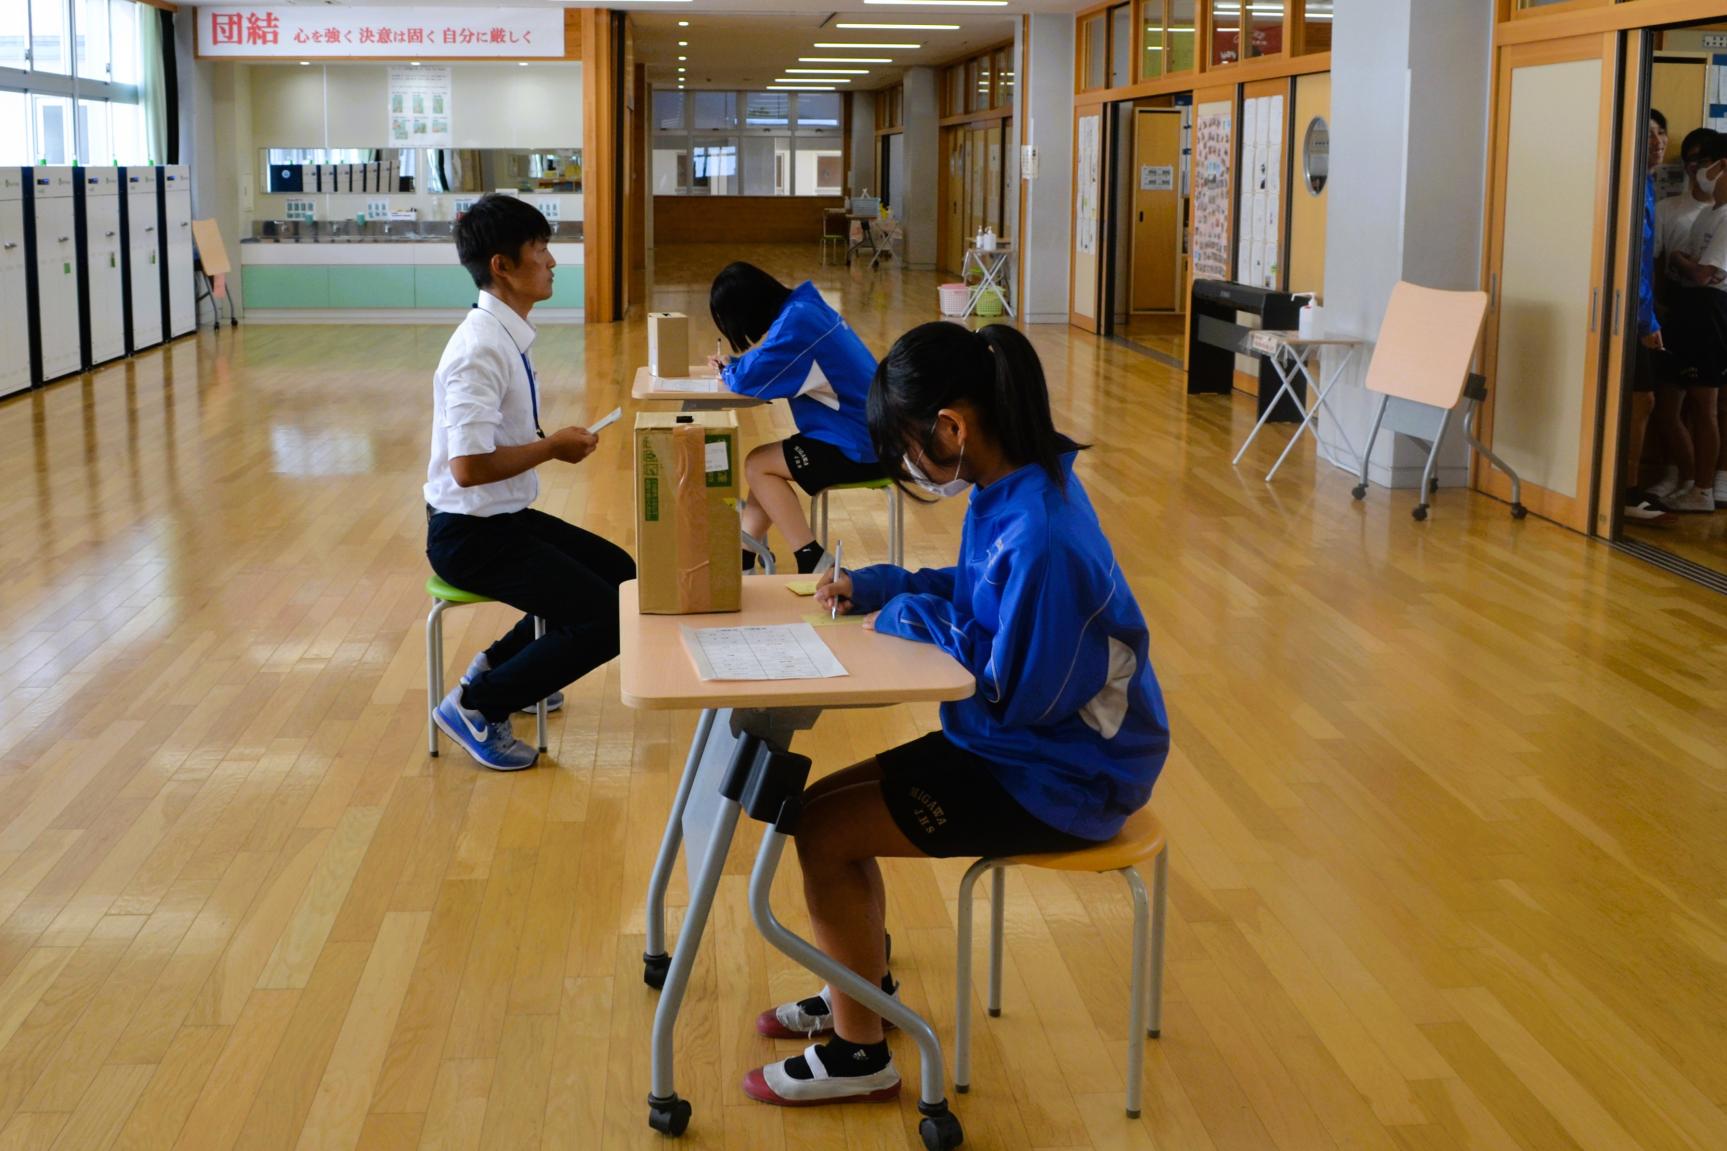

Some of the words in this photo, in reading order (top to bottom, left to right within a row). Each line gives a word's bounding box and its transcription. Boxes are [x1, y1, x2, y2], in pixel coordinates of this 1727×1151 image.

[212, 12, 280, 46] 団結
[294, 27, 353, 44] 心を強く
[359, 27, 435, 44] 決意は固く
[443, 28, 532, 44] 自分に厳しく
